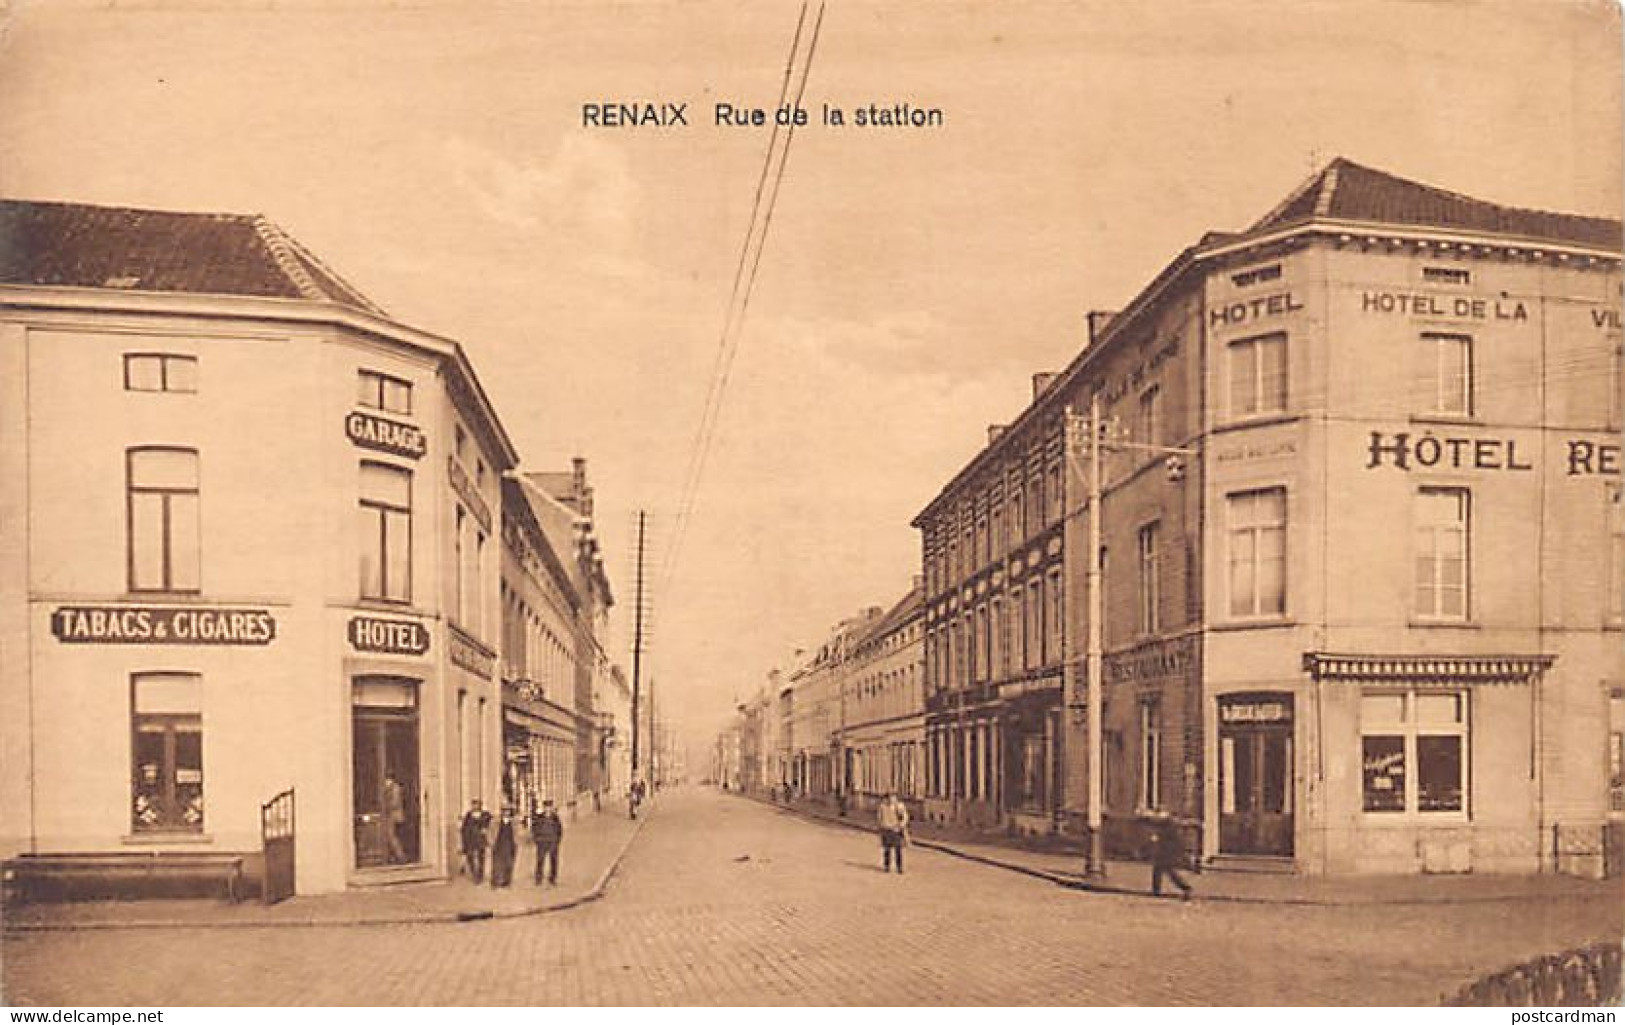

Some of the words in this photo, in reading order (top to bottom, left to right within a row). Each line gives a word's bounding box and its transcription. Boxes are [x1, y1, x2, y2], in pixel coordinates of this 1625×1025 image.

[1210, 292, 1304, 327] HOTEL
[1362, 293, 1444, 315] HOTEL
[1455, 299, 1487, 318] DE
[1495, 300, 1529, 322] LA
[349, 415, 425, 454] GARAGE
[60, 611, 152, 639] TABACS
[155, 618, 168, 638] &
[173, 611, 271, 642] CIGARES
[355, 619, 424, 650] HOTEL
